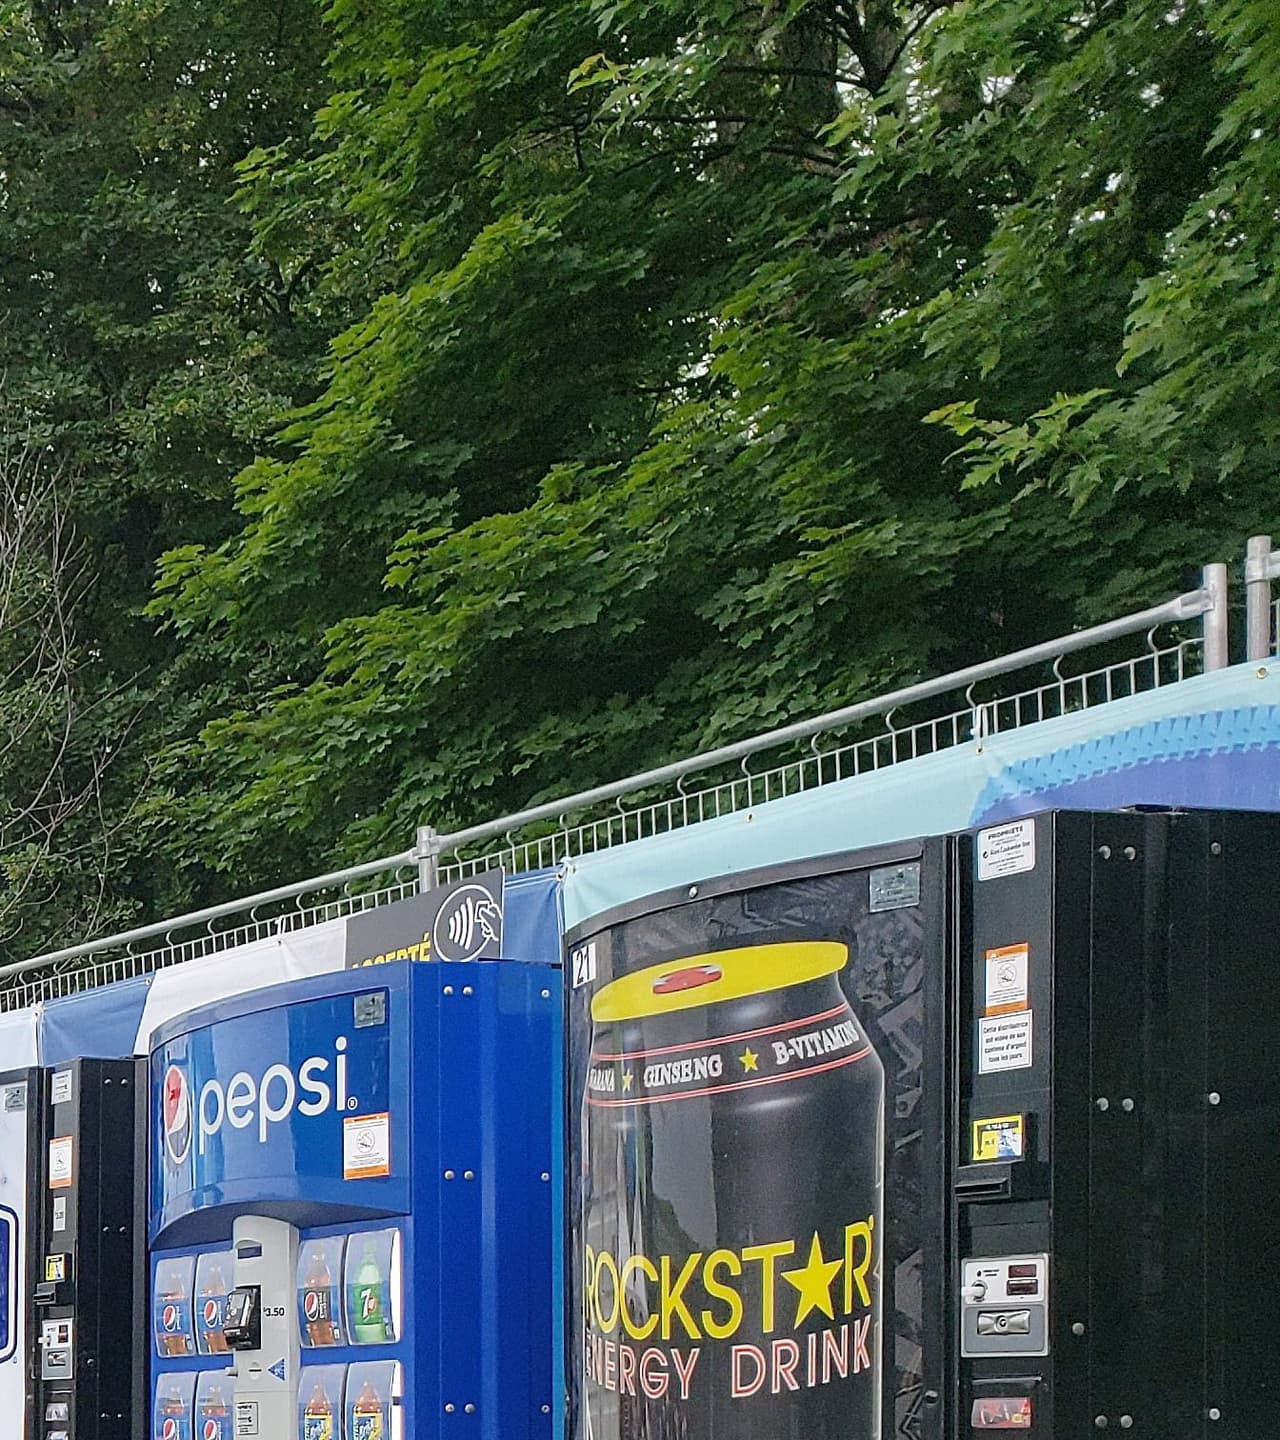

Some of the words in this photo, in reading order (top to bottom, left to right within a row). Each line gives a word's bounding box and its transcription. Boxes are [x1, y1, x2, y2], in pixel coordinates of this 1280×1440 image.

[577, 947, 591, 983] 21
[199, 1036, 347, 1155] pepsi
[643, 1054, 723, 1089] GINSENG
[731, 1314, 872, 1398] DRINK
